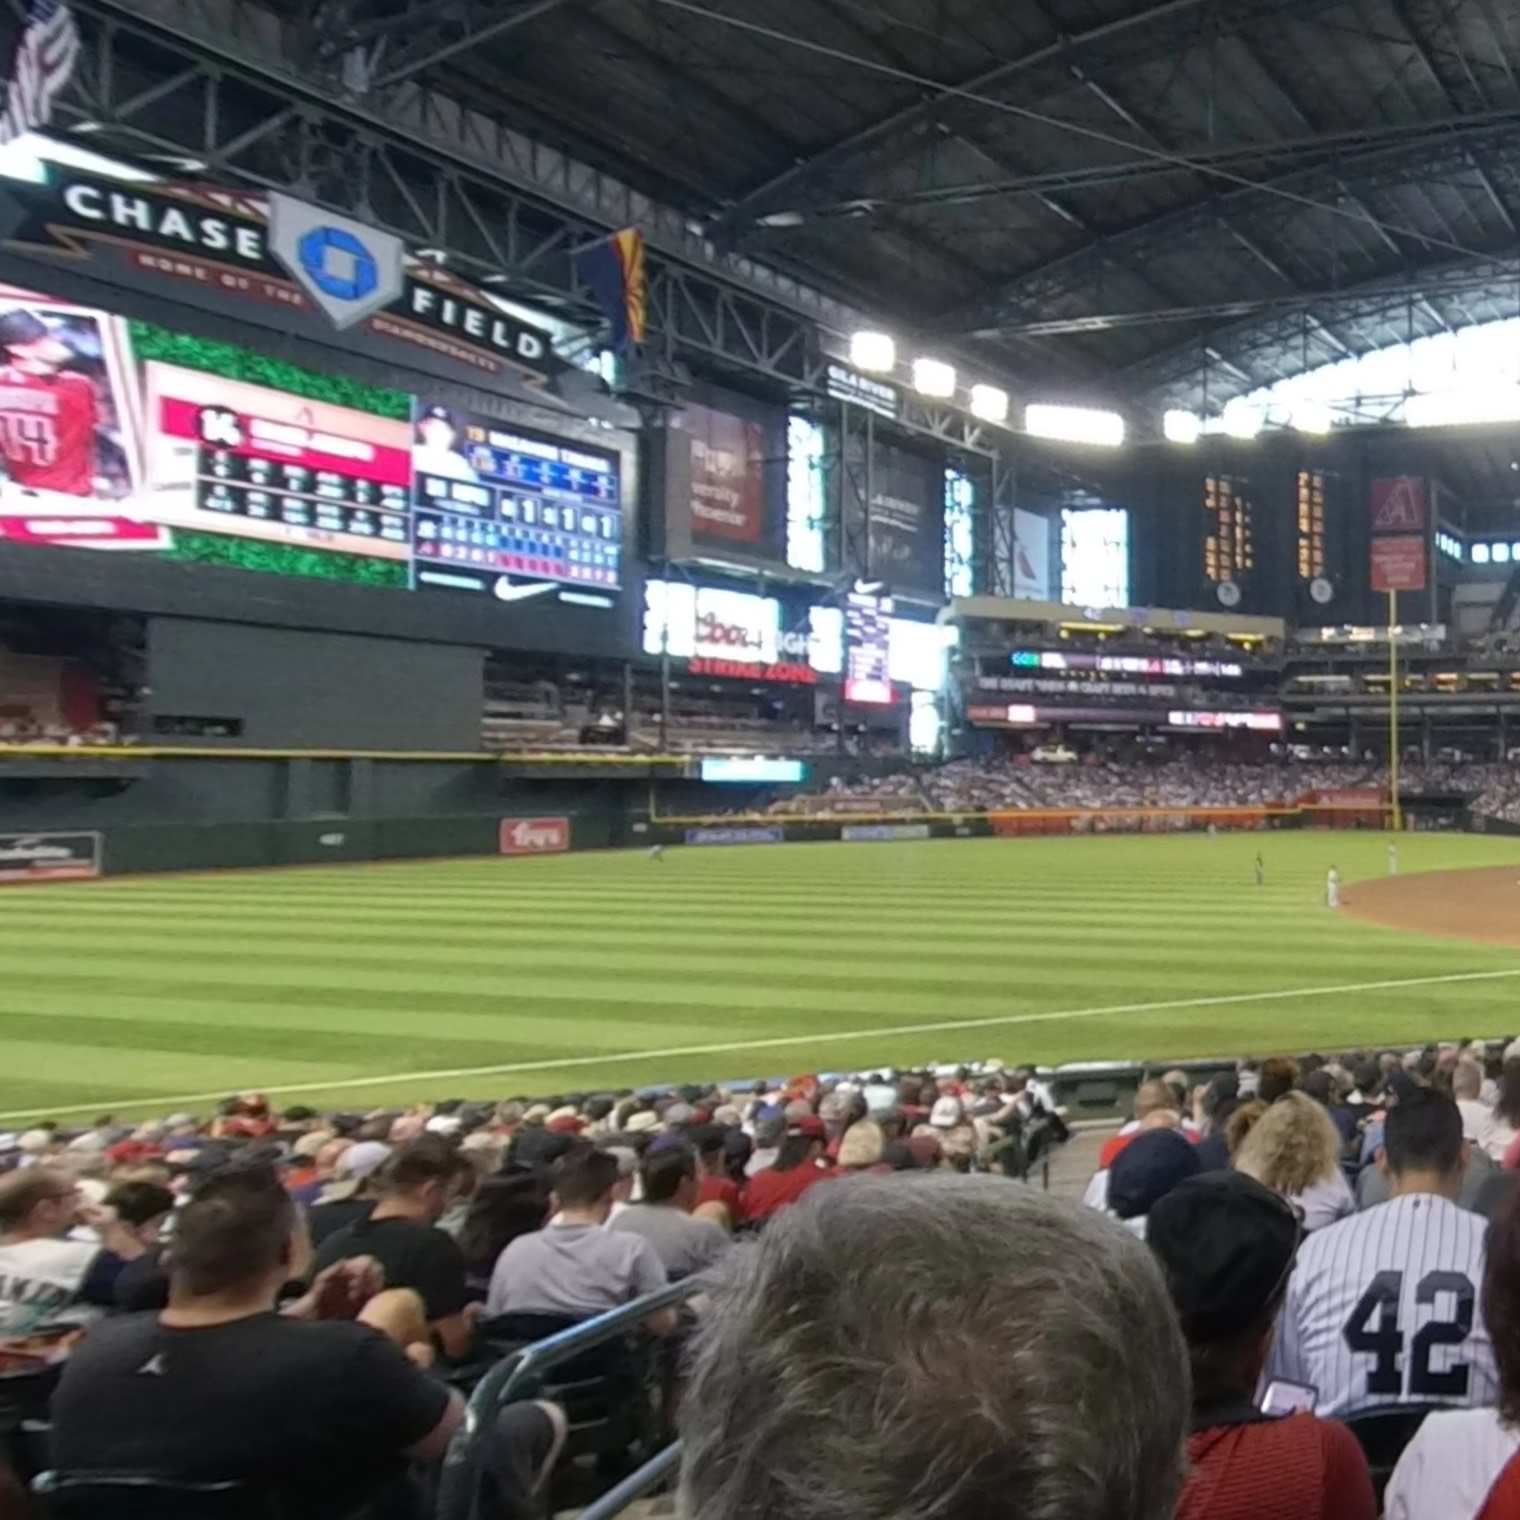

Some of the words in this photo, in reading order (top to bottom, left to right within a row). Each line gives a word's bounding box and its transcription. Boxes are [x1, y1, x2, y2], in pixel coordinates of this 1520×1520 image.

[64, 184, 262, 260] CHASE
[412, 287, 544, 359] FIELD
[137, 253, 208, 280] HOME
[220, 274, 250, 289] OF
[263, 283, 303, 305] THE
[687, 656, 762, 680] STRIKE
[764, 661, 818, 684] ZONE
[1342, 1269, 1476, 1395] 42
